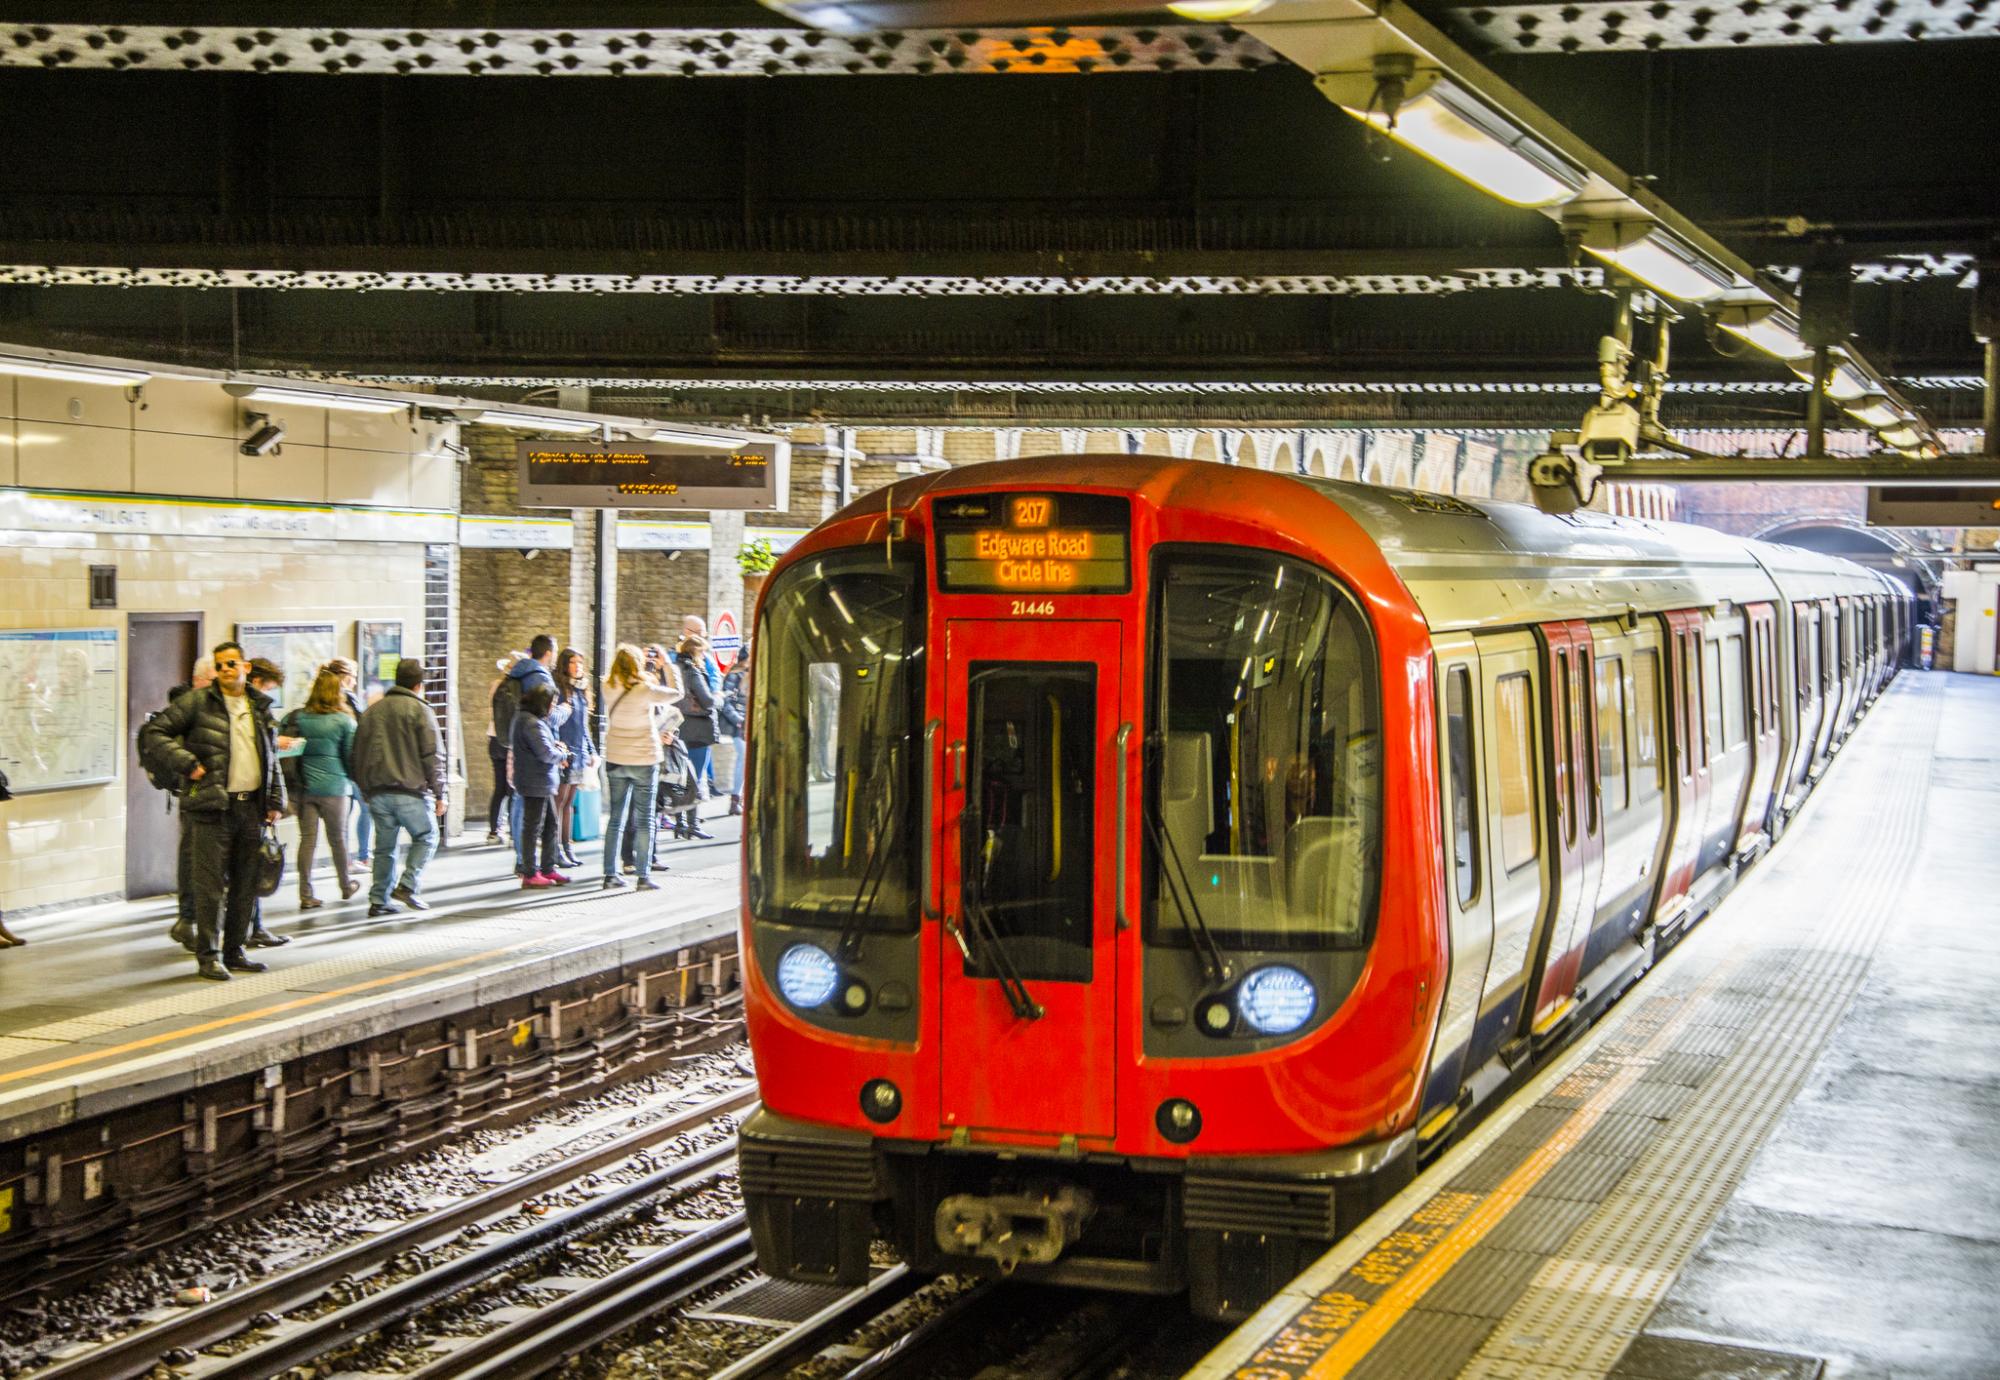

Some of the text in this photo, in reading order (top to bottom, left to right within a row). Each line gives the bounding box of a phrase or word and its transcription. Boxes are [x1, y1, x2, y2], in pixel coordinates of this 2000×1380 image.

[1016, 502, 1048, 525] 207
[977, 532, 1089, 559] Edgware Road
[999, 560, 1072, 583] Circle line
[1011, 600, 1055, 616] 21446
[1252, 1291, 1370, 1365] THE GAP
